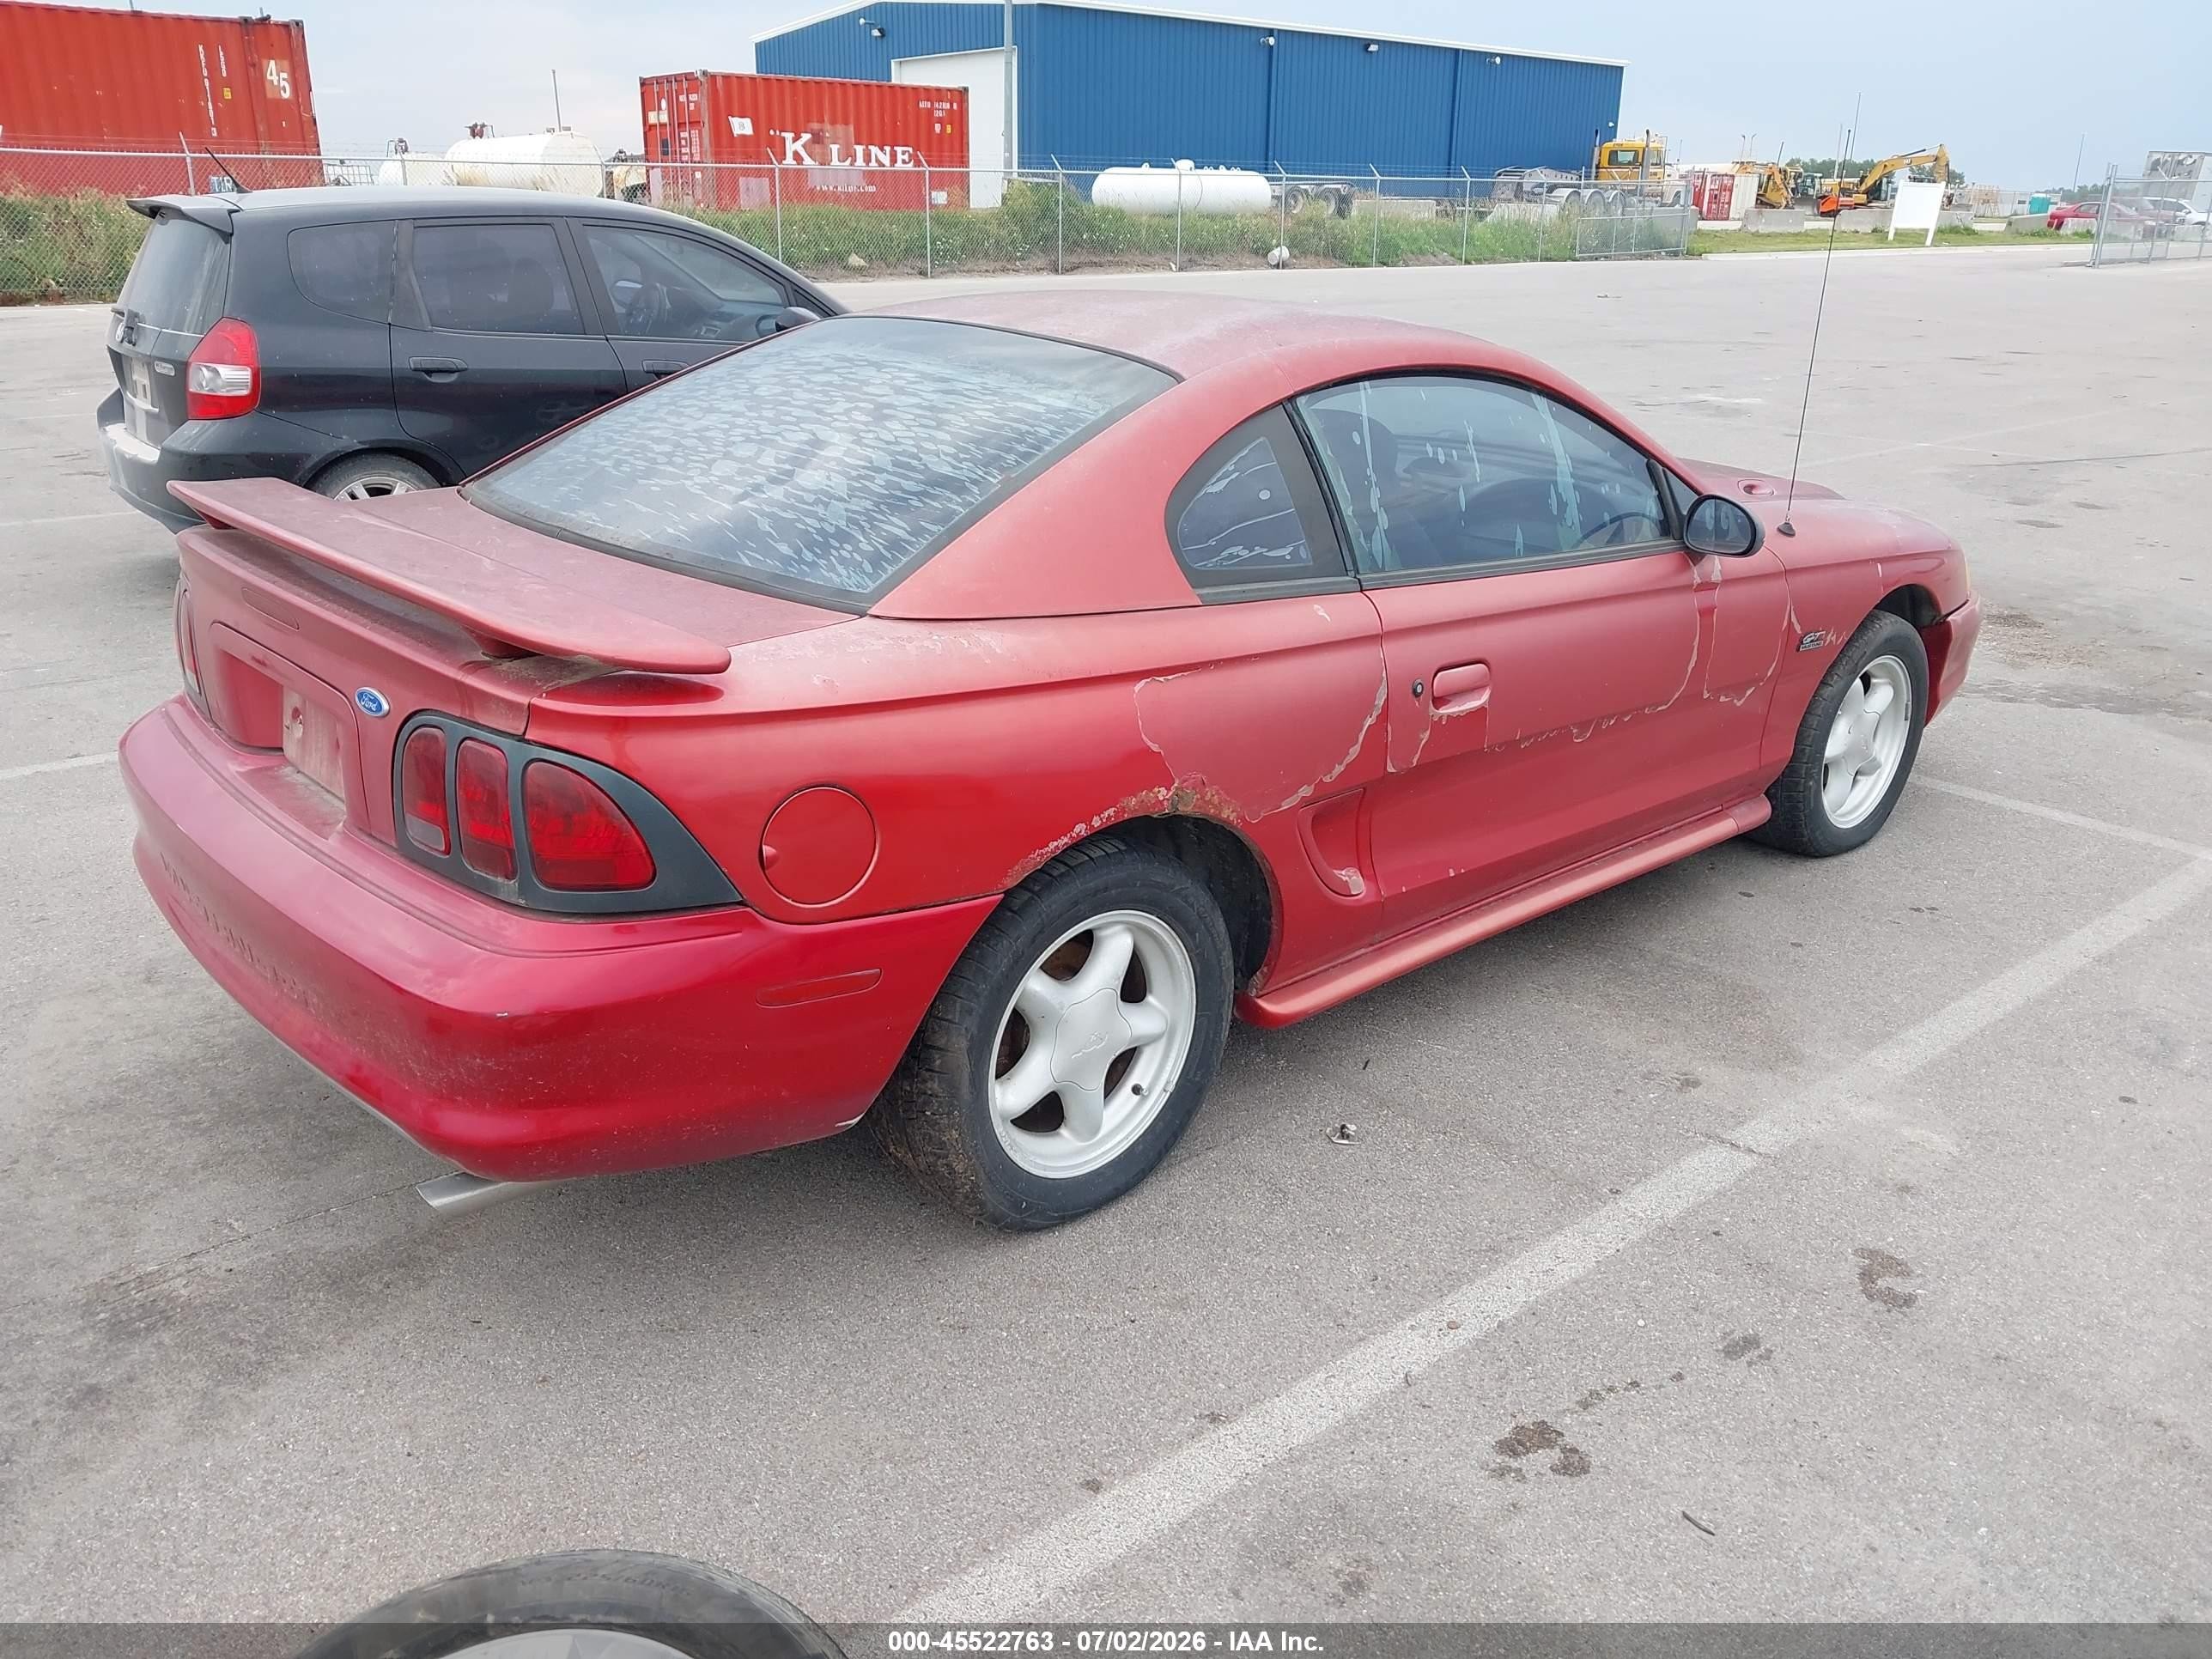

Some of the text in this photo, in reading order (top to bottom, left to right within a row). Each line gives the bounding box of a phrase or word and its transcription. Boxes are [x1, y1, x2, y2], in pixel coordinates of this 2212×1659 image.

[266, 59, 290, 99] 45
[830, 143, 915, 167] LINE
[360, 692, 380, 712] Ford
